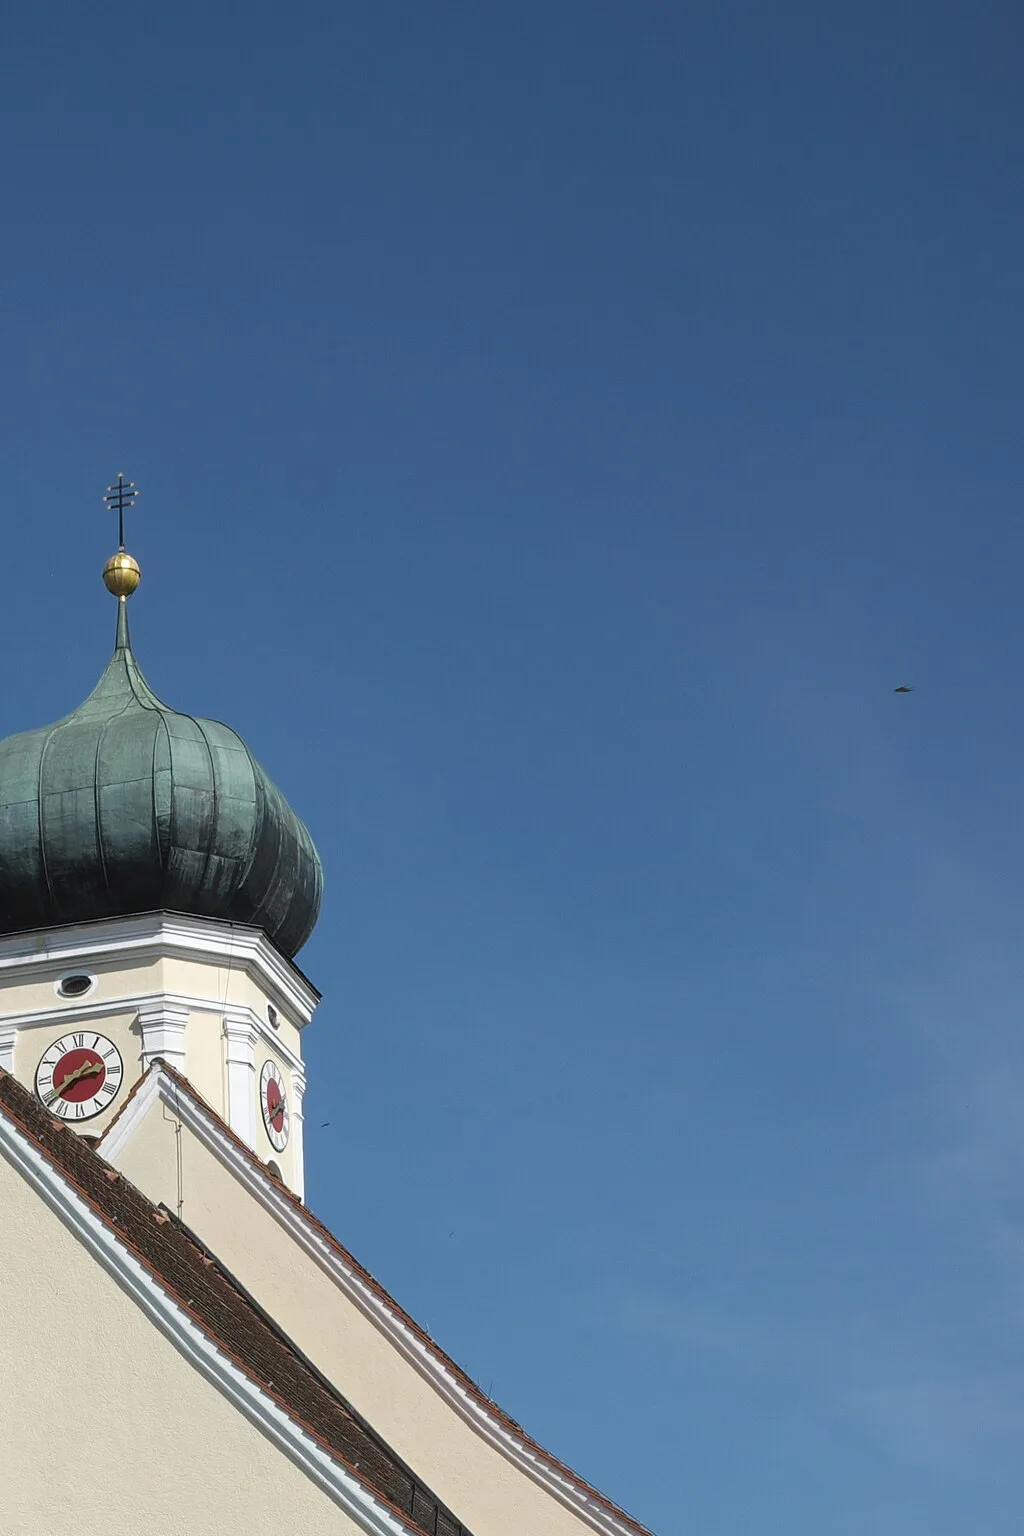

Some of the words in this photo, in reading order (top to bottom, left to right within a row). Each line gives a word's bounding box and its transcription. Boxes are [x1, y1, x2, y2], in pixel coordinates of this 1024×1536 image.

[72, 1034, 84, 1048] XII
[92, 1036, 100, 1049] I
[54, 1041, 68, 1056] XI
[102, 1048, 115, 1059] II
[42, 1057, 56, 1068] X
[107, 1065, 120, 1075] III
[76, 1103, 85, 1117] VI
[93, 1098, 104, 1110] V
